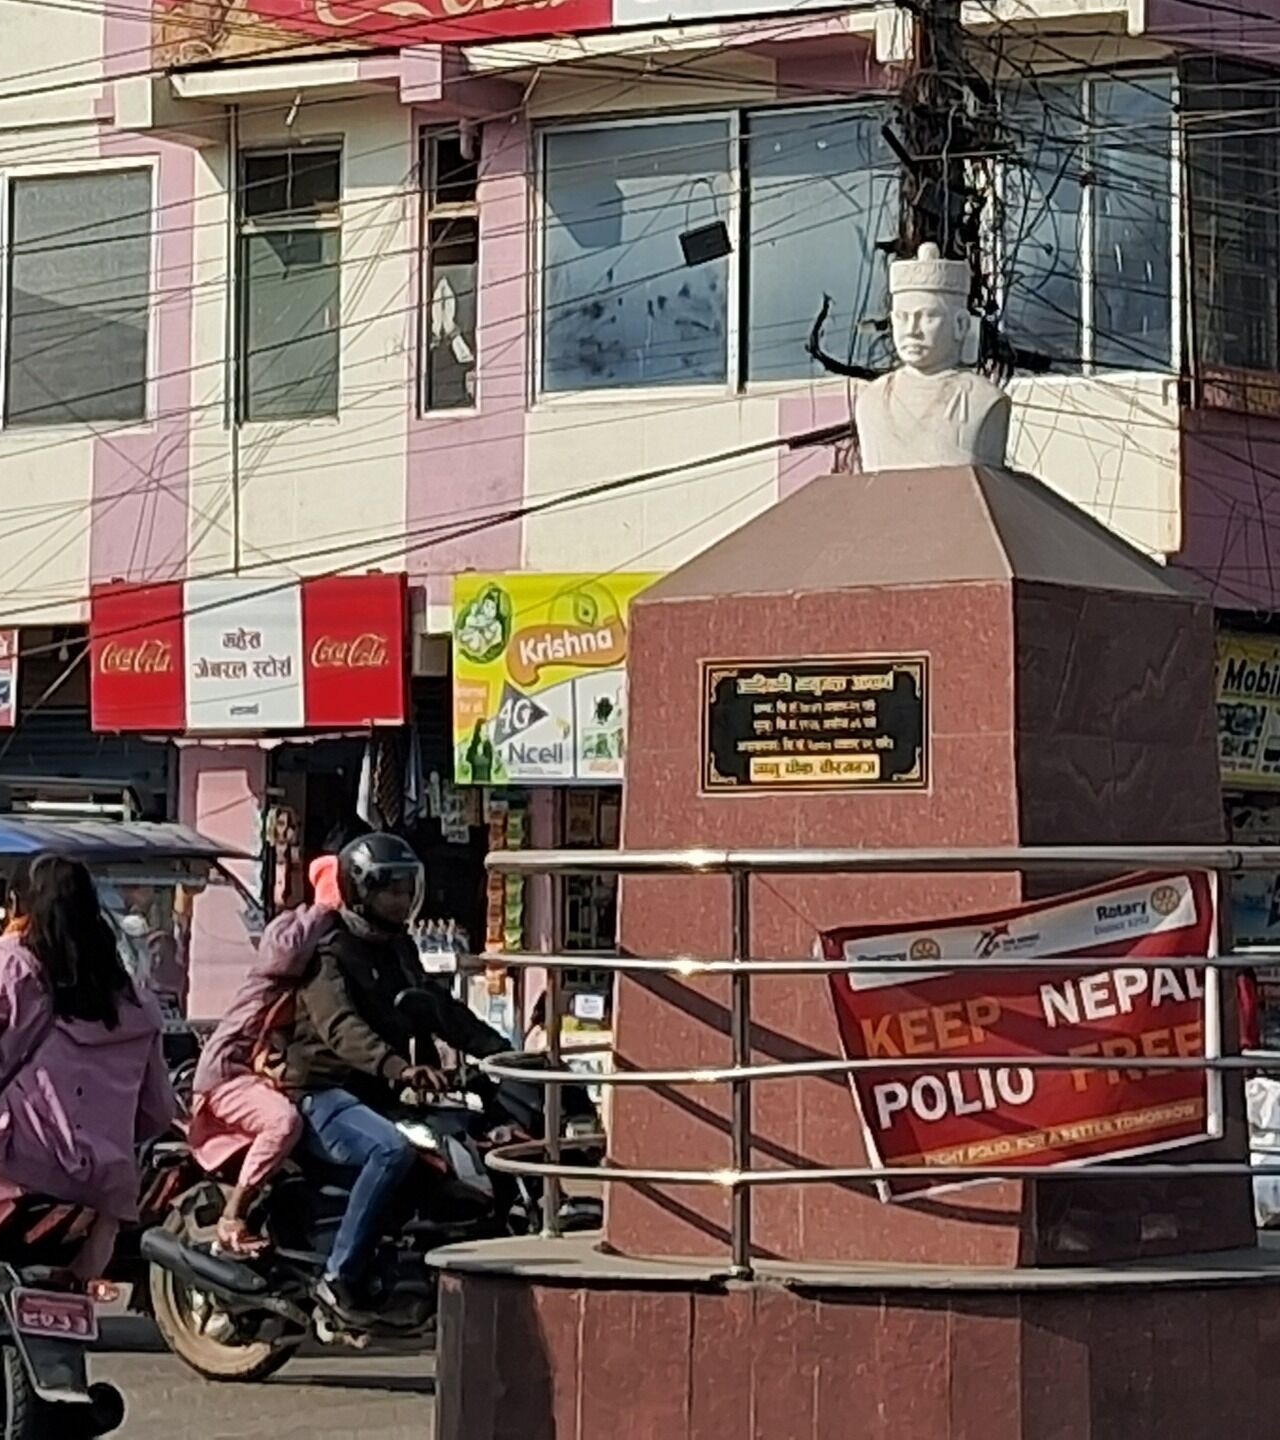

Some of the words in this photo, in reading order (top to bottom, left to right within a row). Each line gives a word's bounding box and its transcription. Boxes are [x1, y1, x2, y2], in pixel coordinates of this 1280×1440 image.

[520, 628, 613, 666] Krishna
[500, 697, 532, 734] 4G
[508, 742, 563, 765] Ncell
[1096, 900, 1147, 921] Rotary
[861, 996, 1001, 1059] KEEP
[1039, 967, 1205, 1028] NEPAL
[873, 1067, 1036, 1130] POLIO
[1068, 1021, 1202, 1093] FREE
